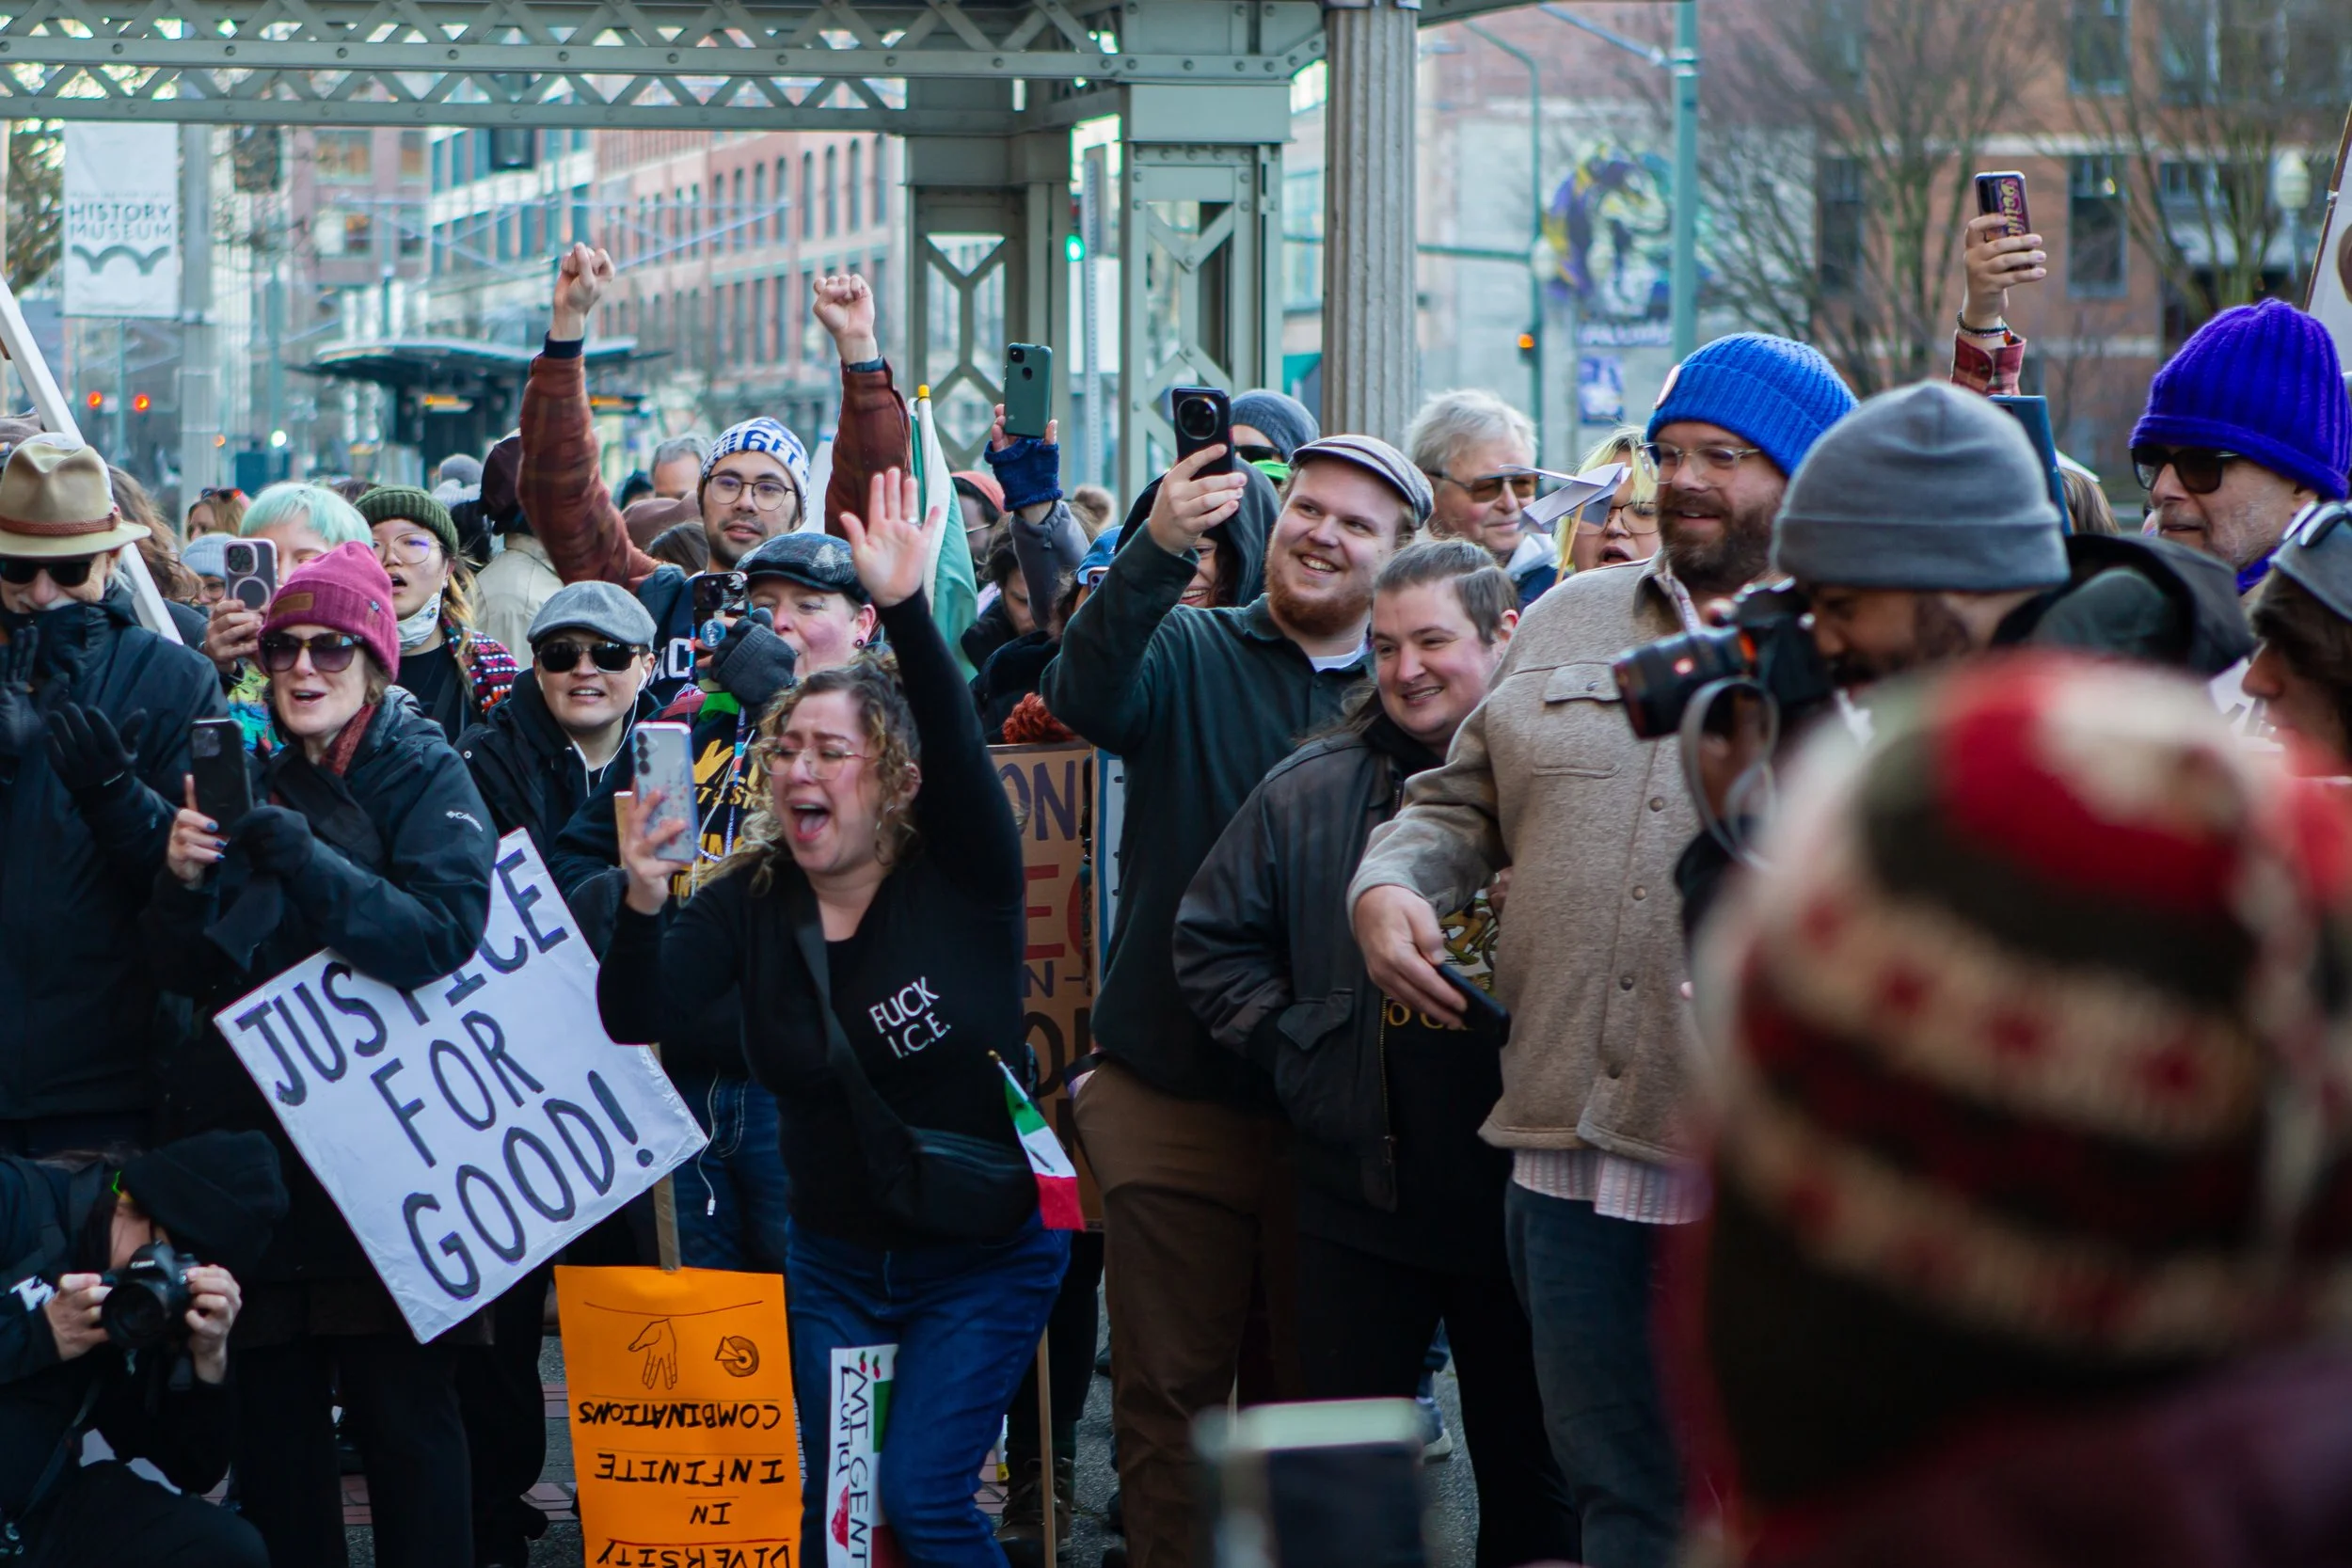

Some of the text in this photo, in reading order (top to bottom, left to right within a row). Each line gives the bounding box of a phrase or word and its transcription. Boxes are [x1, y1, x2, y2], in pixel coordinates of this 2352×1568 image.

[69, 201, 171, 222] HISTORY
[69, 223, 171, 241] MUSEUM
[868, 976, 940, 1034] FUCK
[887, 1011, 951, 1059] I.C.E.
[370, 1009, 546, 1169] FOR
[403, 1070, 655, 1301] GOOD!
[578, 1401, 782, 1430] COMBINATIONS
[594, 1452, 786, 1487] INFINITE
[690, 1502, 733, 1526] IN
[596, 1541, 791, 1568] DIVERSITY
